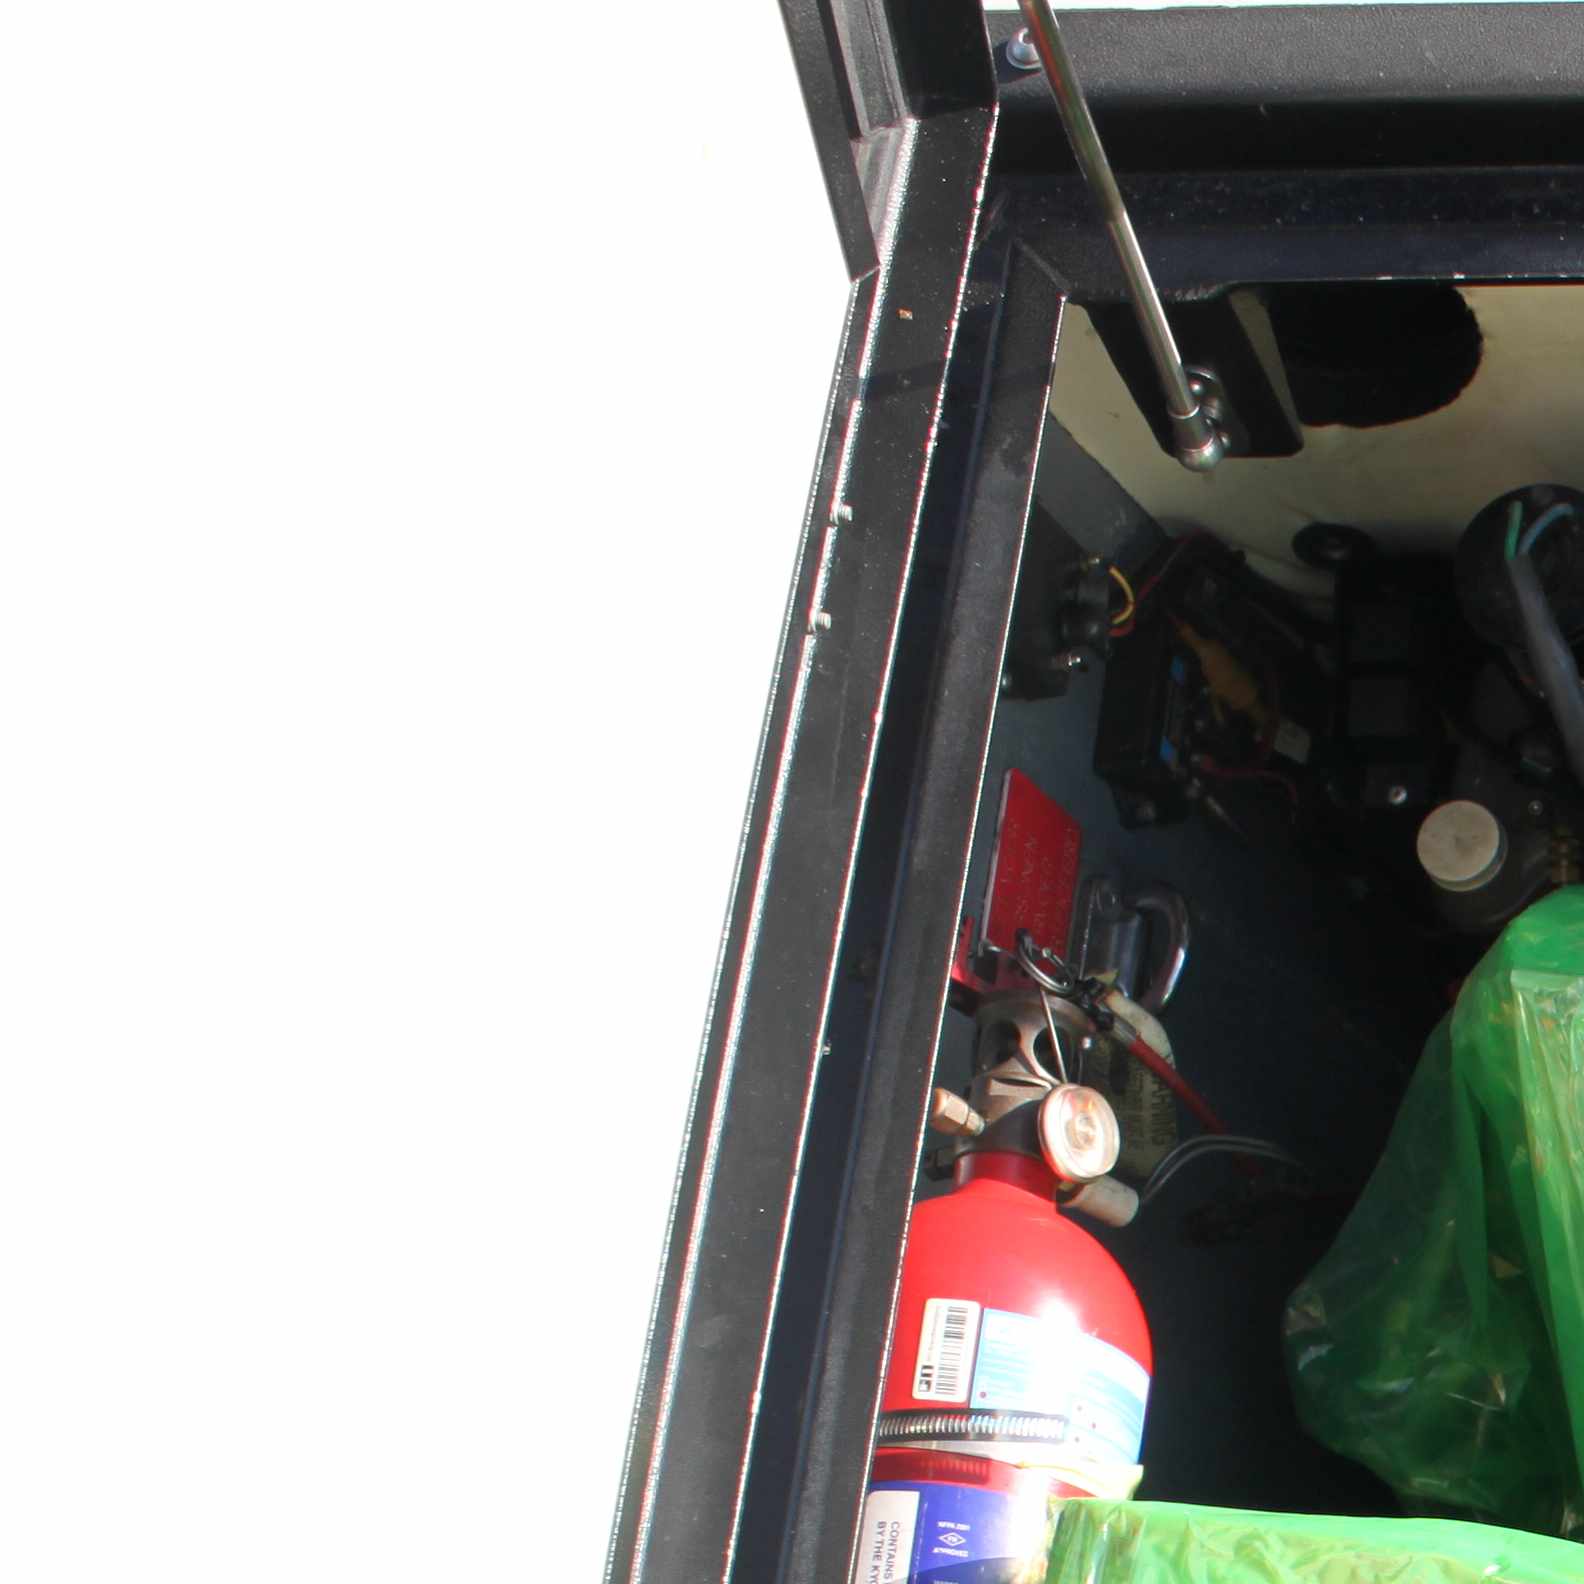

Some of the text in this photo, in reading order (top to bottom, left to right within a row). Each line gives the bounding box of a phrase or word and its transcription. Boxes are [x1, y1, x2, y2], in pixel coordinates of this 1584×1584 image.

[876, 1521, 887, 1536] BY
[872, 1540, 884, 1561] THE
[884, 1521, 900, 1579] CONTAINS
